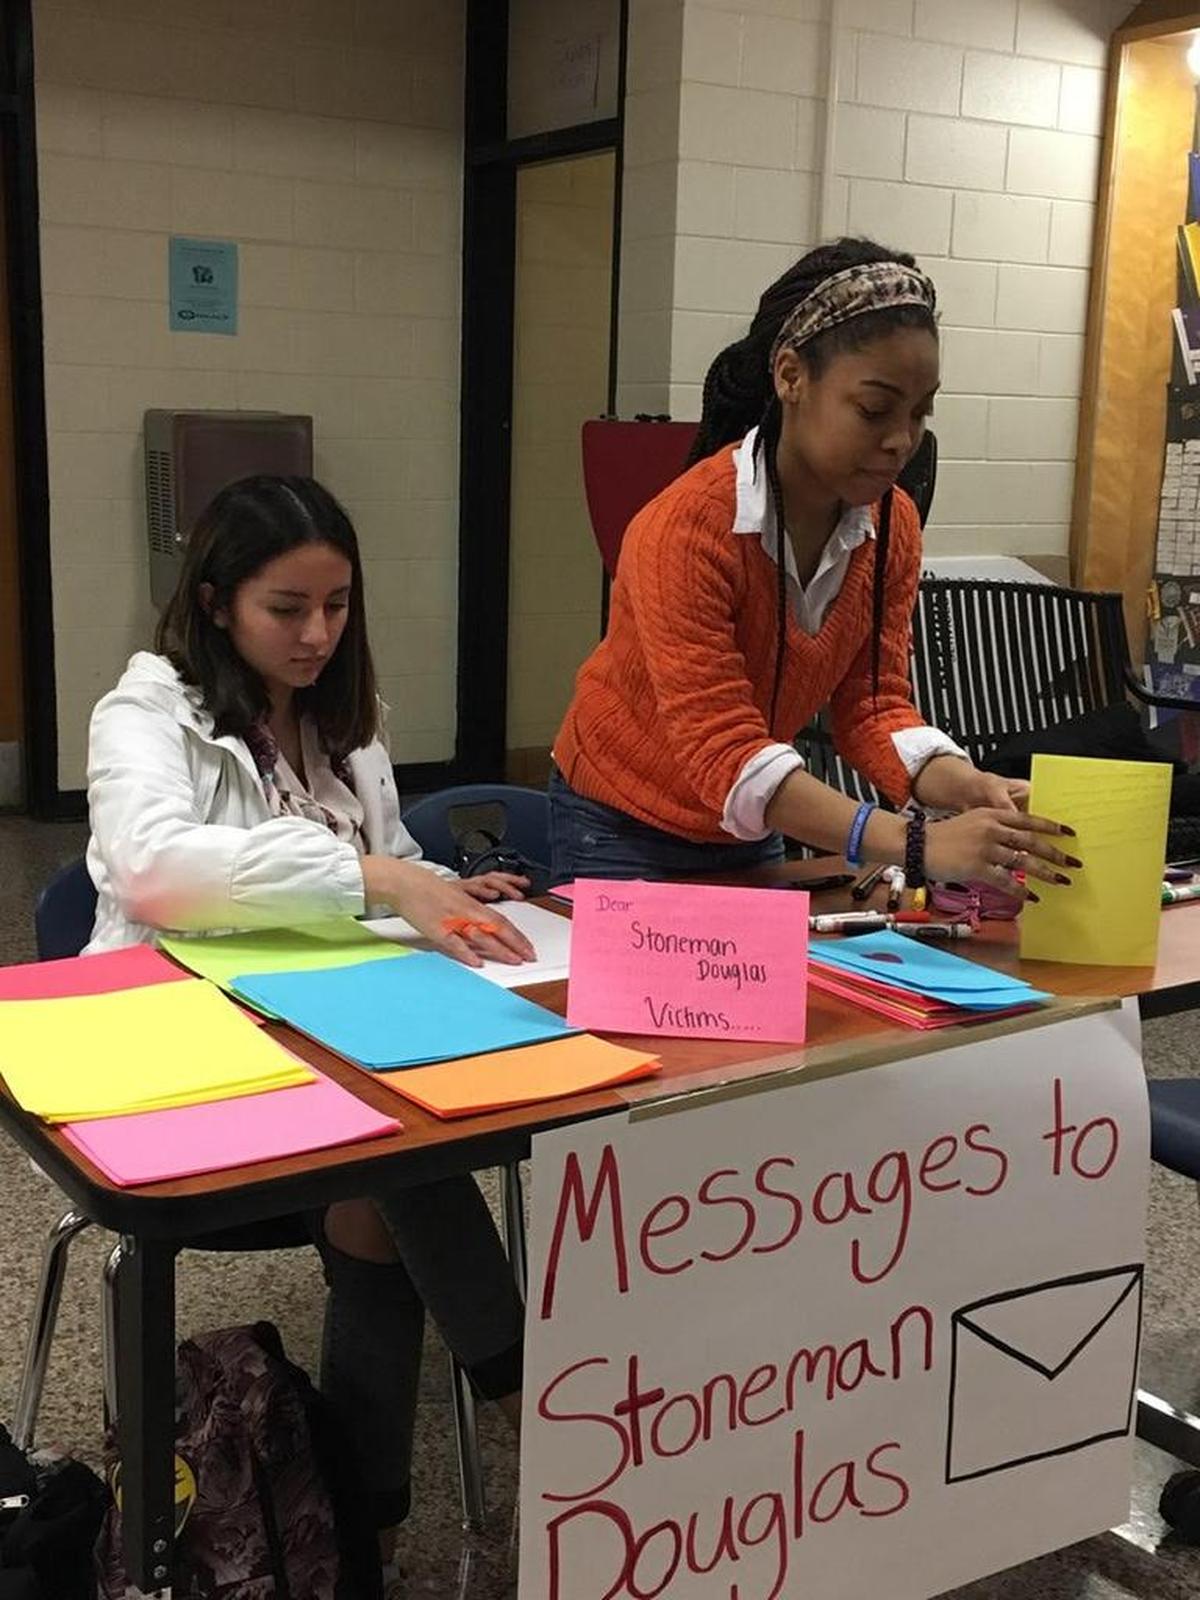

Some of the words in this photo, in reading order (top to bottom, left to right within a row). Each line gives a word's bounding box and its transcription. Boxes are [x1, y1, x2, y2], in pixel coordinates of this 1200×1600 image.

[595, 894, 633, 912] Dear
[631, 921, 737, 957] Stoneman
[697, 959, 767, 990] Douglas
[541, 1124, 1009, 1320] Messages
[1043, 1078, 1119, 1180] to
[538, 1305, 933, 1501] Stoneman
[546, 1430, 910, 1600] Douglas
